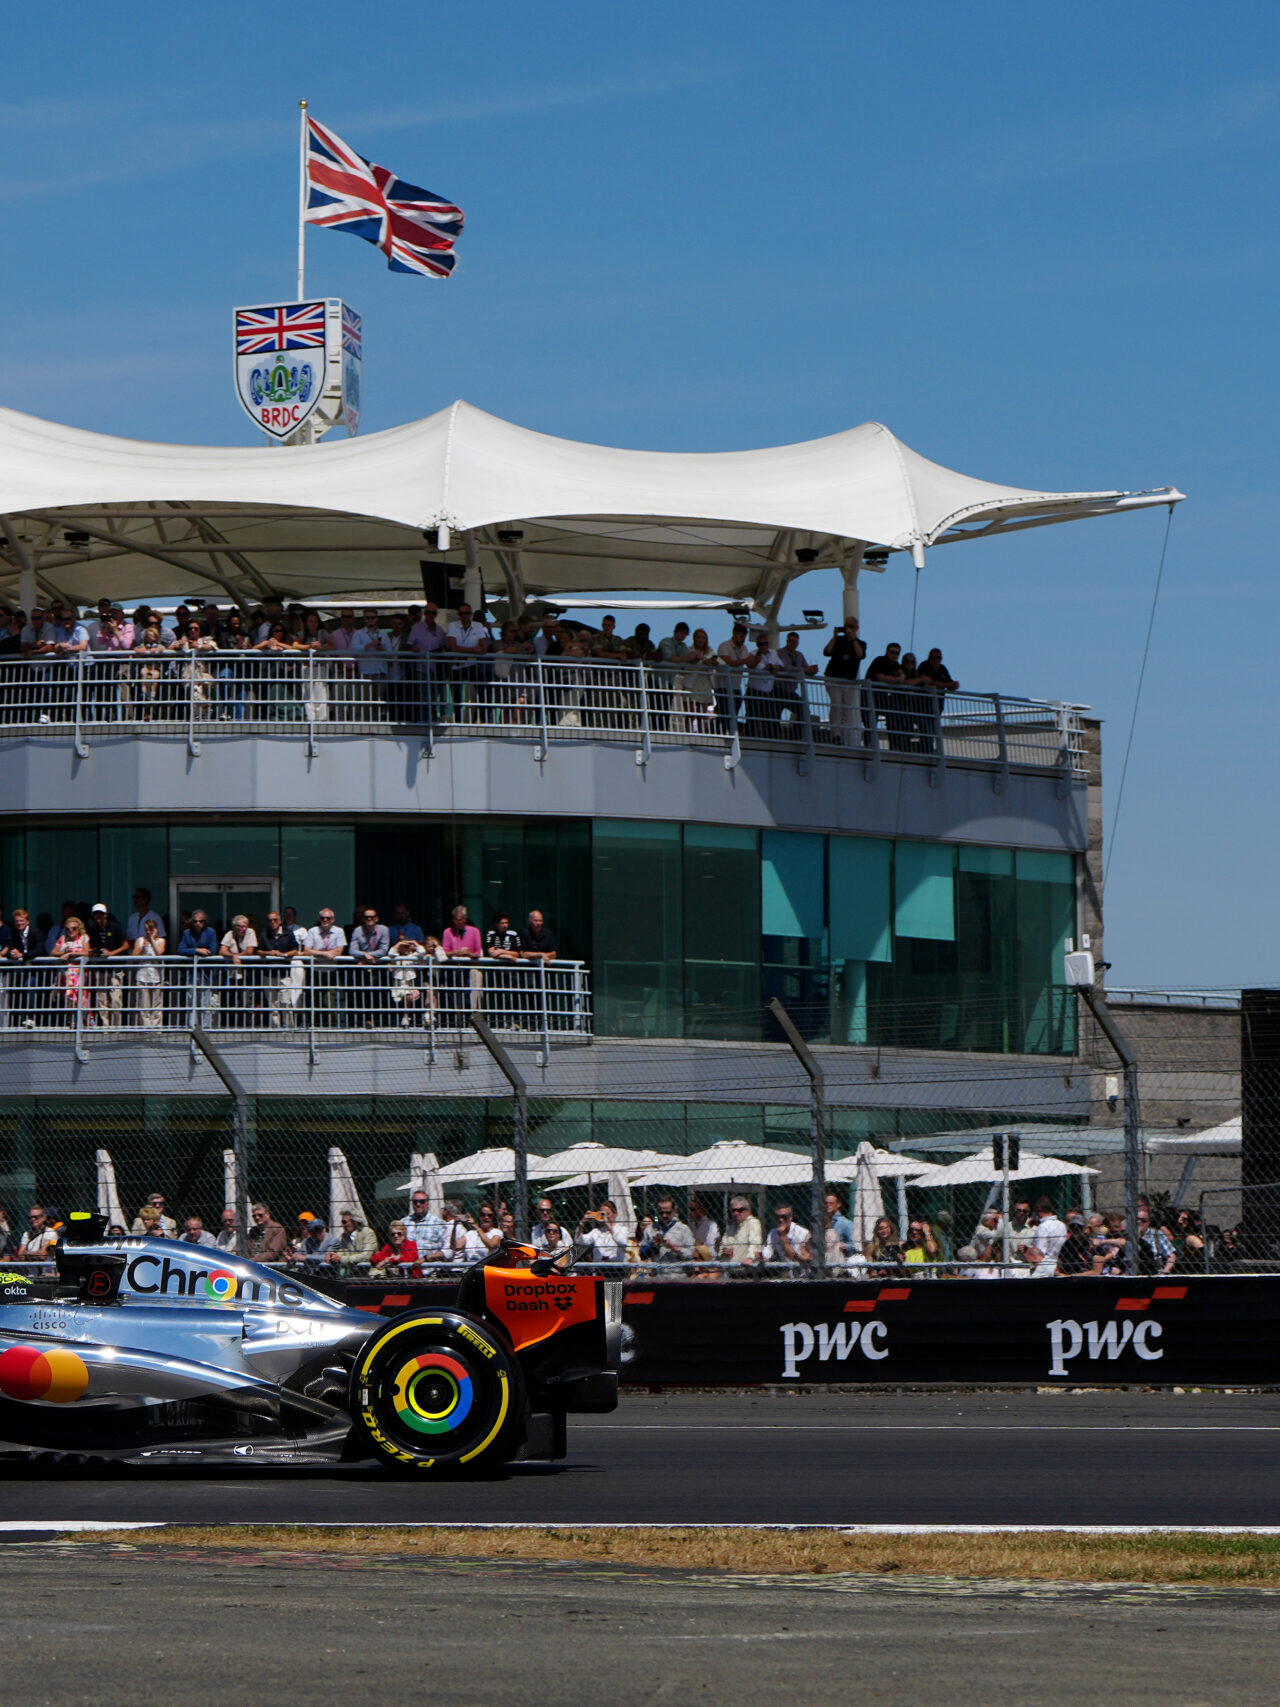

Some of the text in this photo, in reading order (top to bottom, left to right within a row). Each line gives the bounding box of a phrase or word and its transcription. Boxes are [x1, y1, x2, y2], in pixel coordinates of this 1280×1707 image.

[261, 405, 300, 428] BRDC
[4, 1286, 27, 1295] okta
[504, 1282, 577, 1297] Dropbox
[506, 1299, 549, 1311] Dash
[32, 1321, 67, 1330] CISCO
[457, 1323, 497, 1360] PIRELLI
[779, 1319, 890, 1378] pwc
[1046, 1318, 1164, 1376] pwc
[362, 1411, 414, 1463] ZERO
